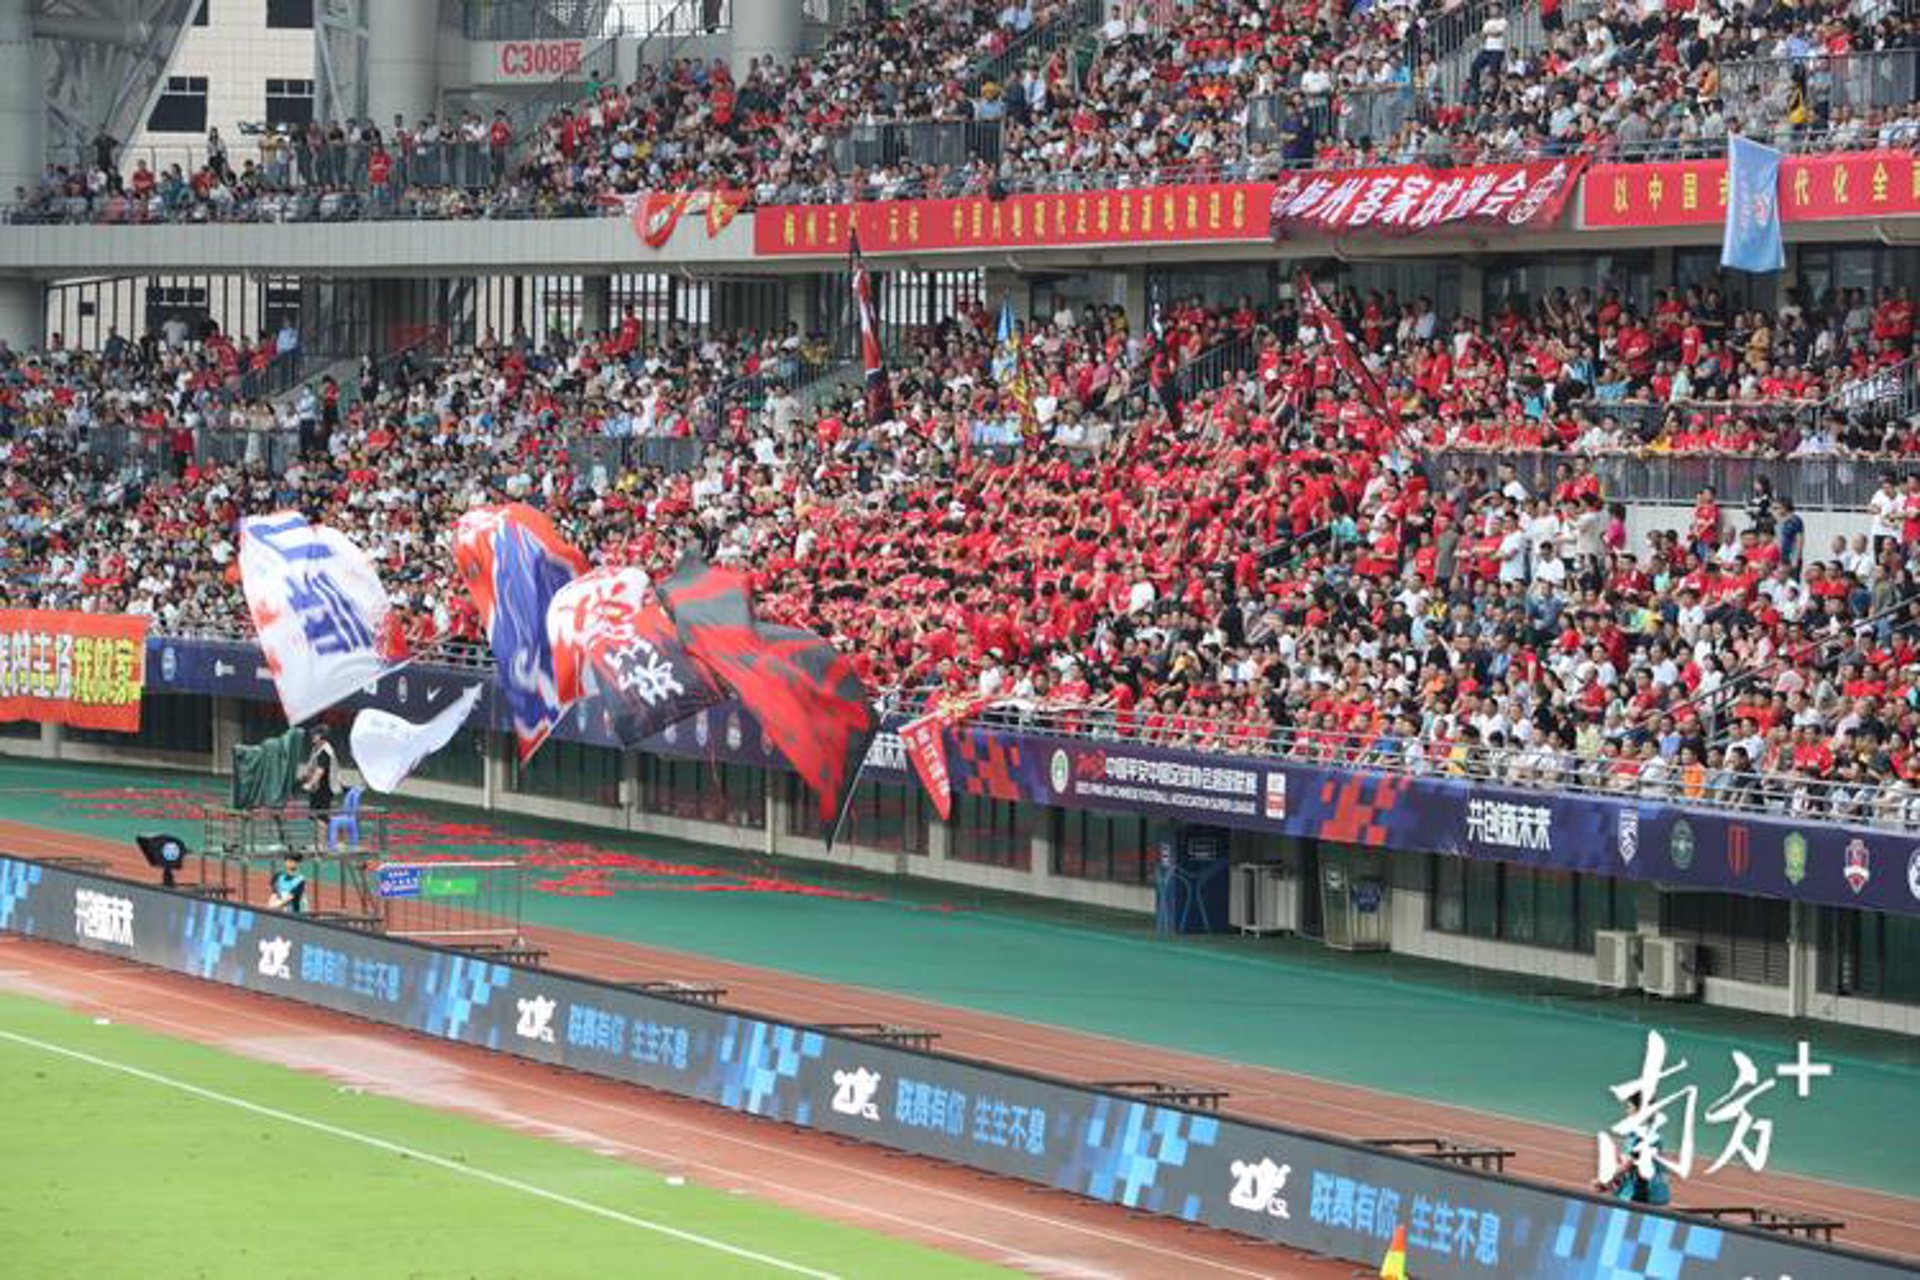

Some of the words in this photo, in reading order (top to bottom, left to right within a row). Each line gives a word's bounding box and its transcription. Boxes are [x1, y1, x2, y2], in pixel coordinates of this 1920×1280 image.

[502, 42, 583, 76] C308区
[1466, 798, 1552, 851] 共创新未来
[1310, 1168, 1400, 1240] 联赛有你
[1407, 1193, 1500, 1267] 生生不息
